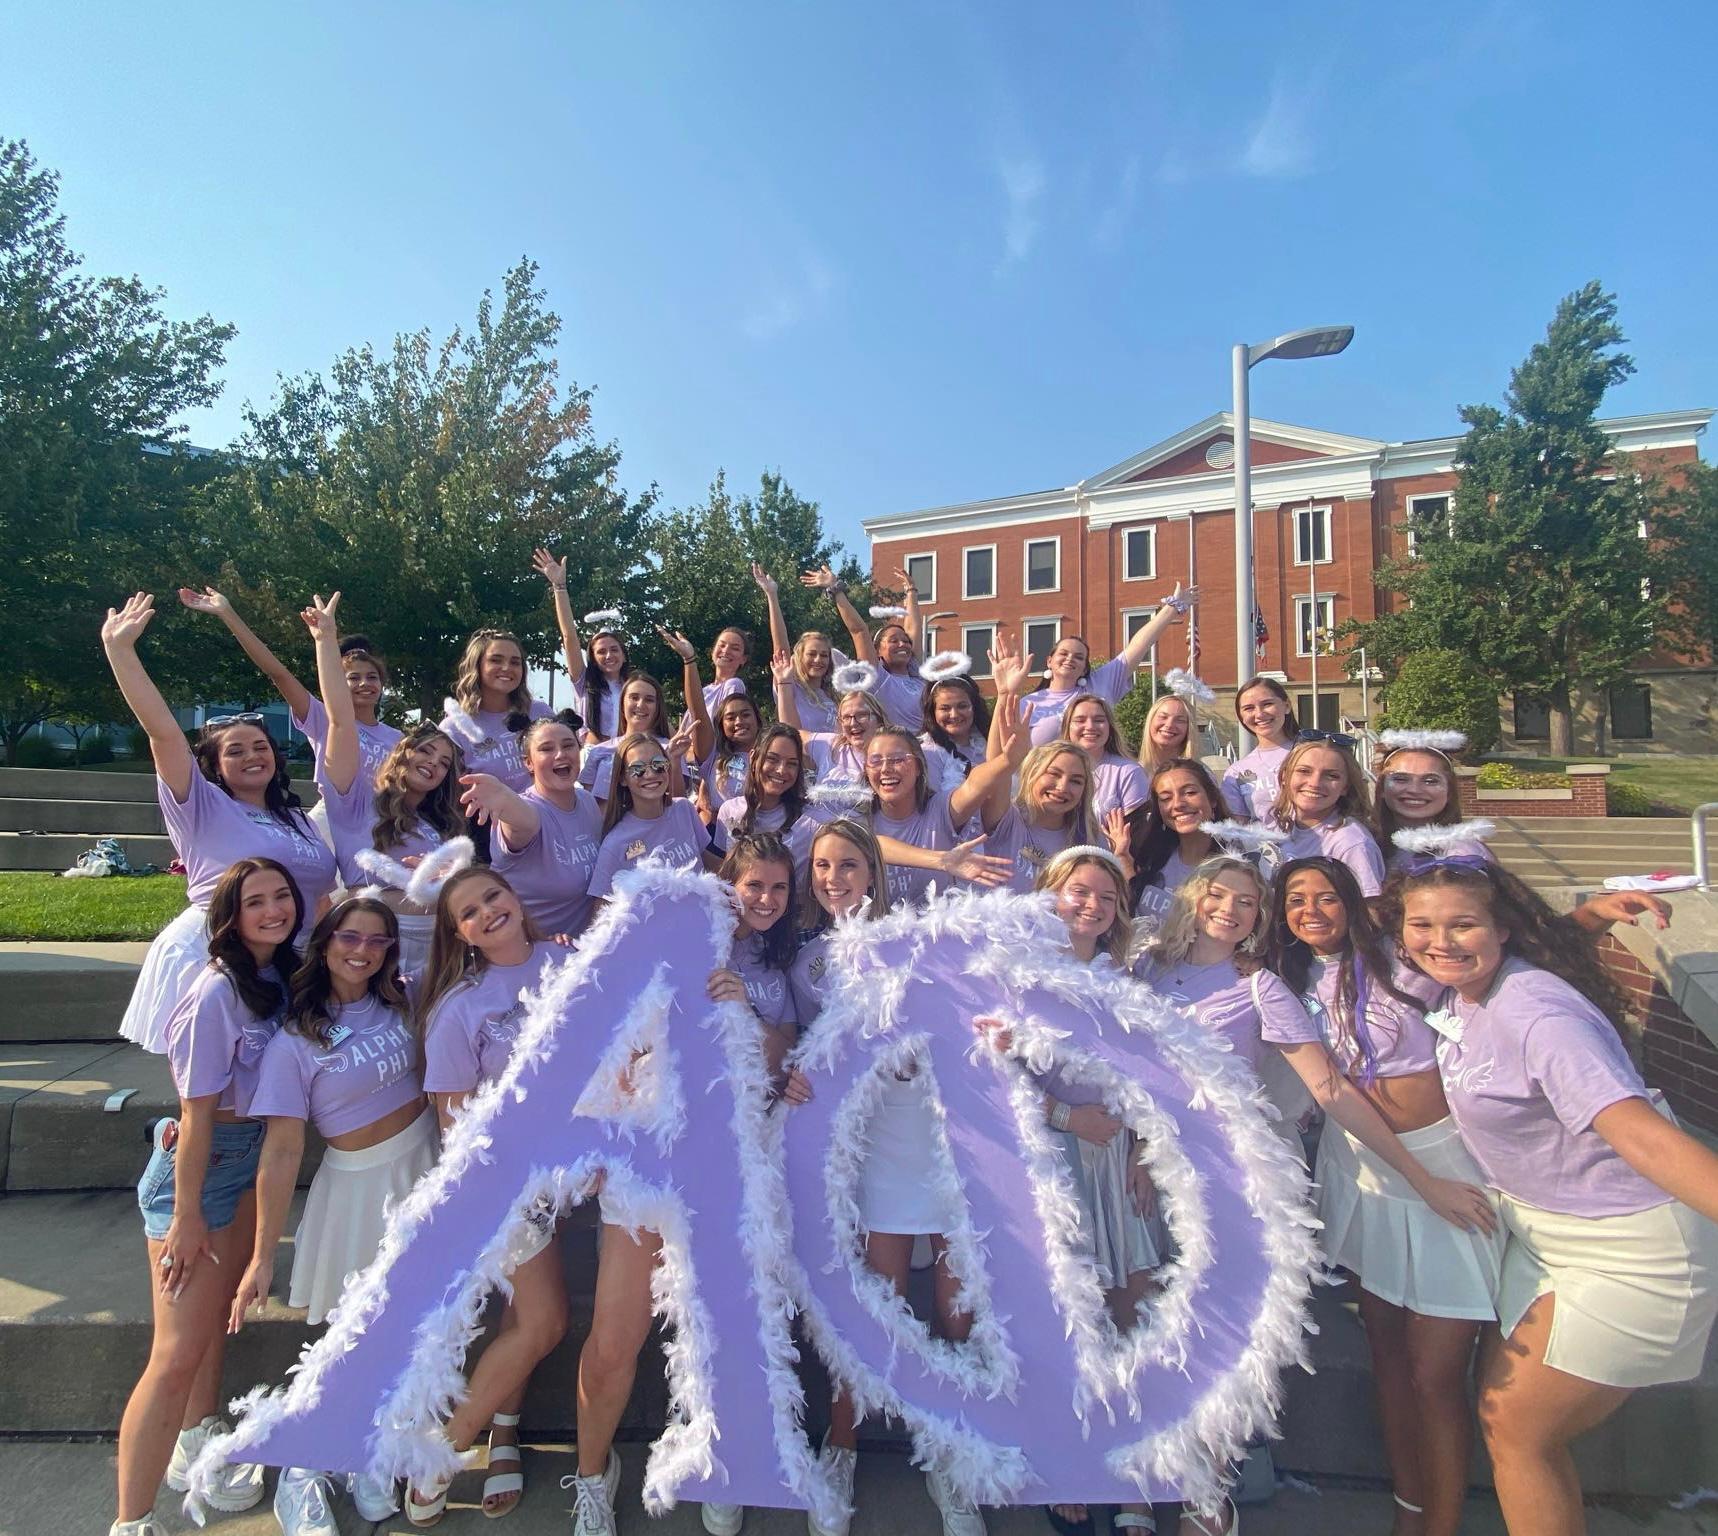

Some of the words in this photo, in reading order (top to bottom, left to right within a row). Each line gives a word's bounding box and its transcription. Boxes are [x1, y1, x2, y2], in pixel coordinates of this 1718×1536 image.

[570, 842, 599, 865] ALPH
[1141, 890, 1171, 913] ALP
[351, 1024, 414, 1068] ALPHA
[376, 1049, 408, 1082] PHI
